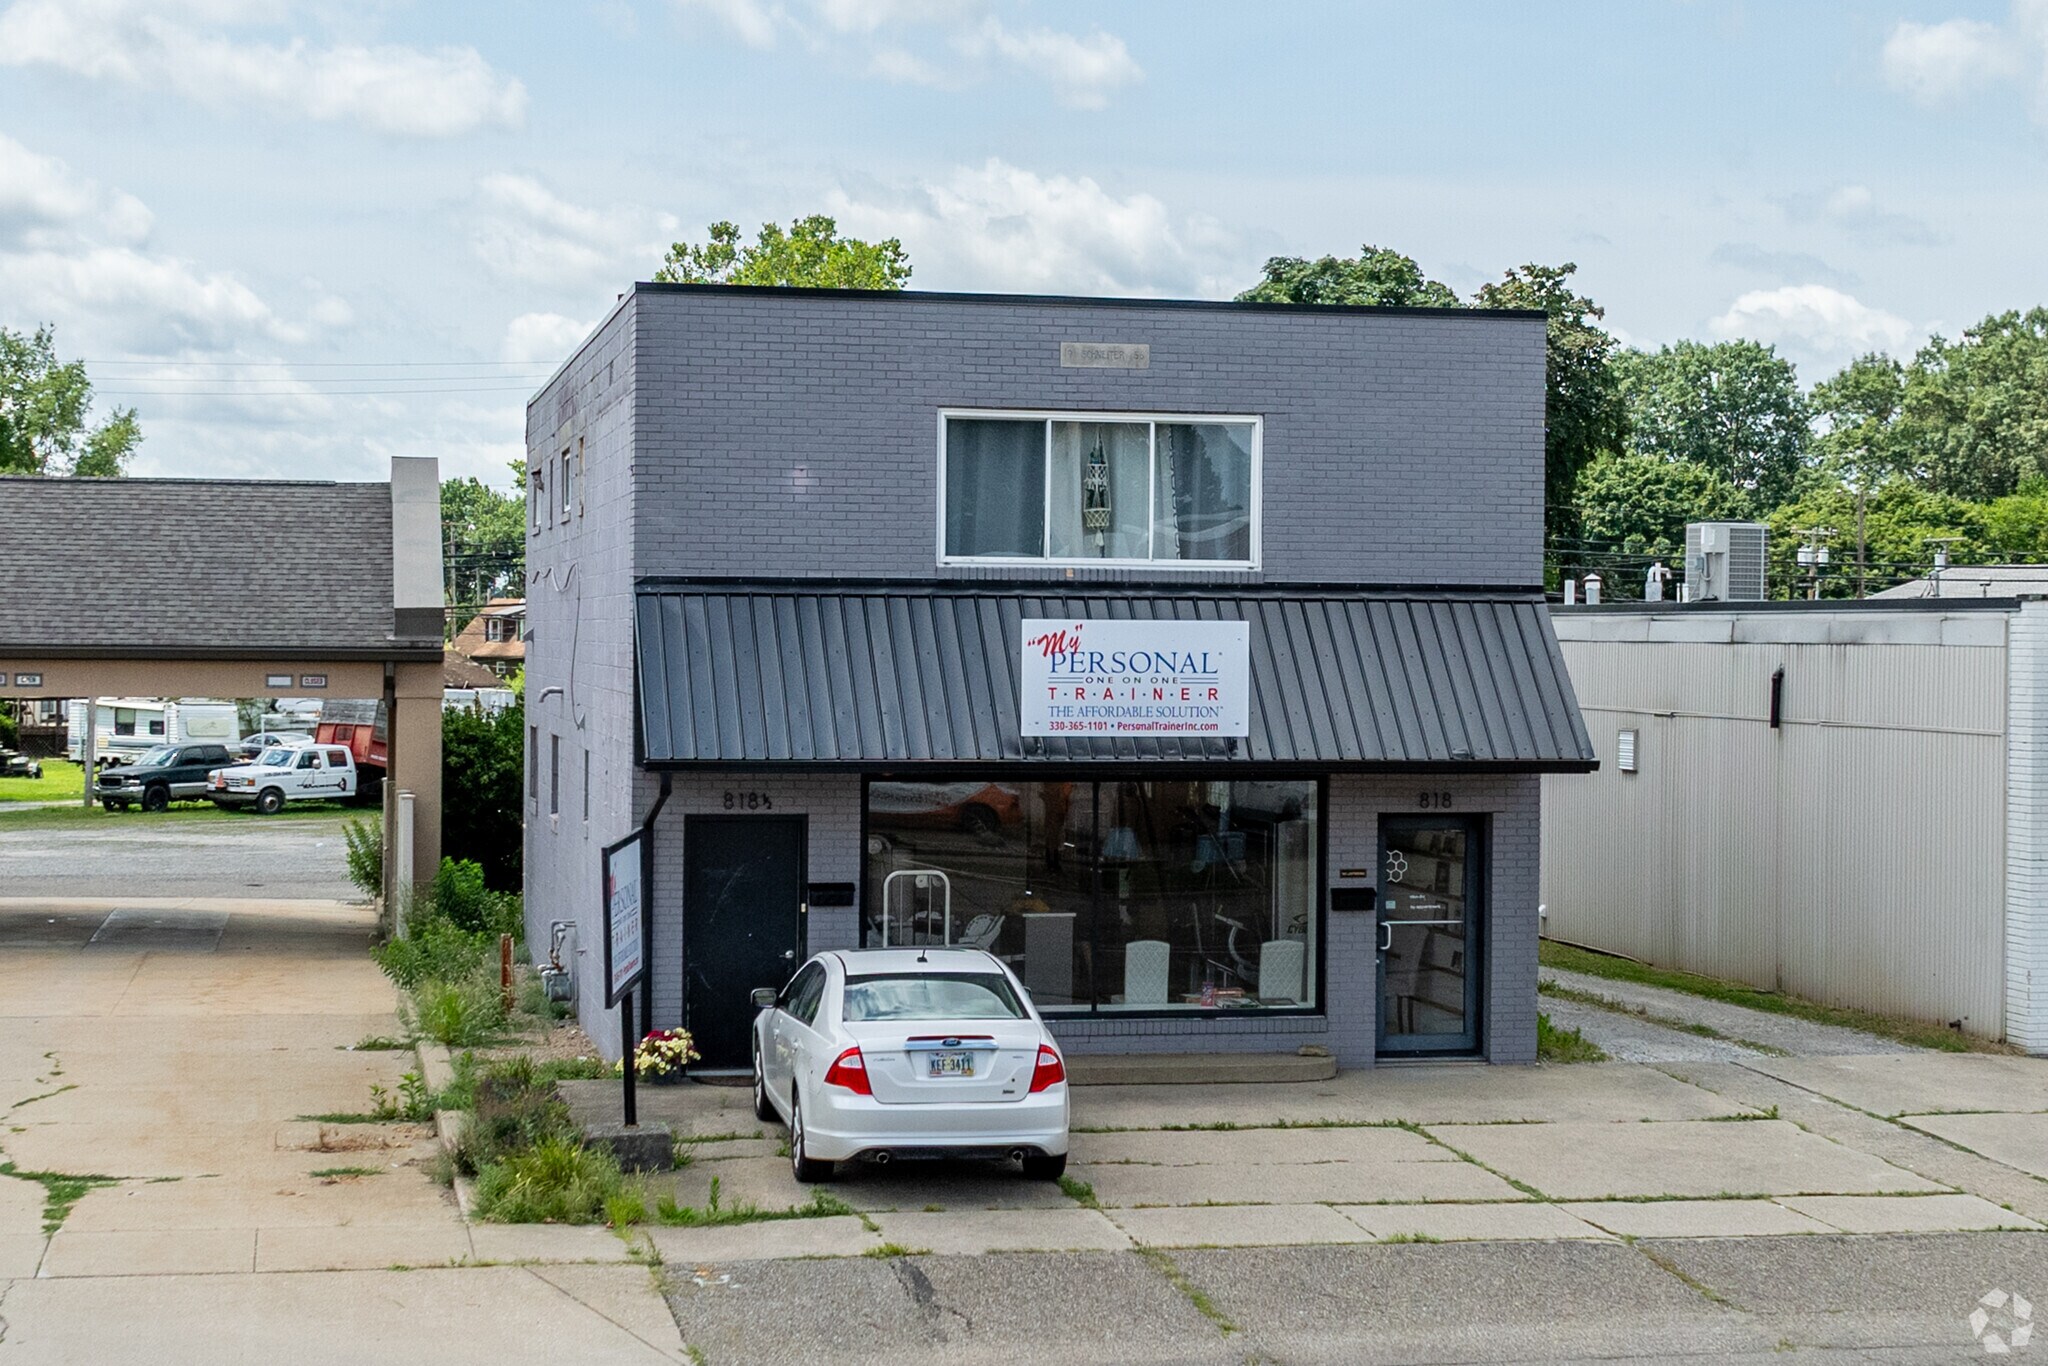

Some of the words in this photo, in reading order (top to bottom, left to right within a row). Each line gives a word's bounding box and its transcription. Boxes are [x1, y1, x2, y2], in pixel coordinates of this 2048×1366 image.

[1050, 651, 1219, 675] PERSONAL
[1085, 676, 1114, 684] ONE
[1122, 676, 1142, 684] ON
[1150, 676, 1179, 684] ONE
[1048, 706, 1074, 718] THE
[1076, 706, 1153, 718] AFFORDABLE
[1049, 721, 1108, 731] 330-365-1101
[1117, 721, 1219, 732] PersonalTrainerInc.com
[1419, 792, 1453, 809] 818
